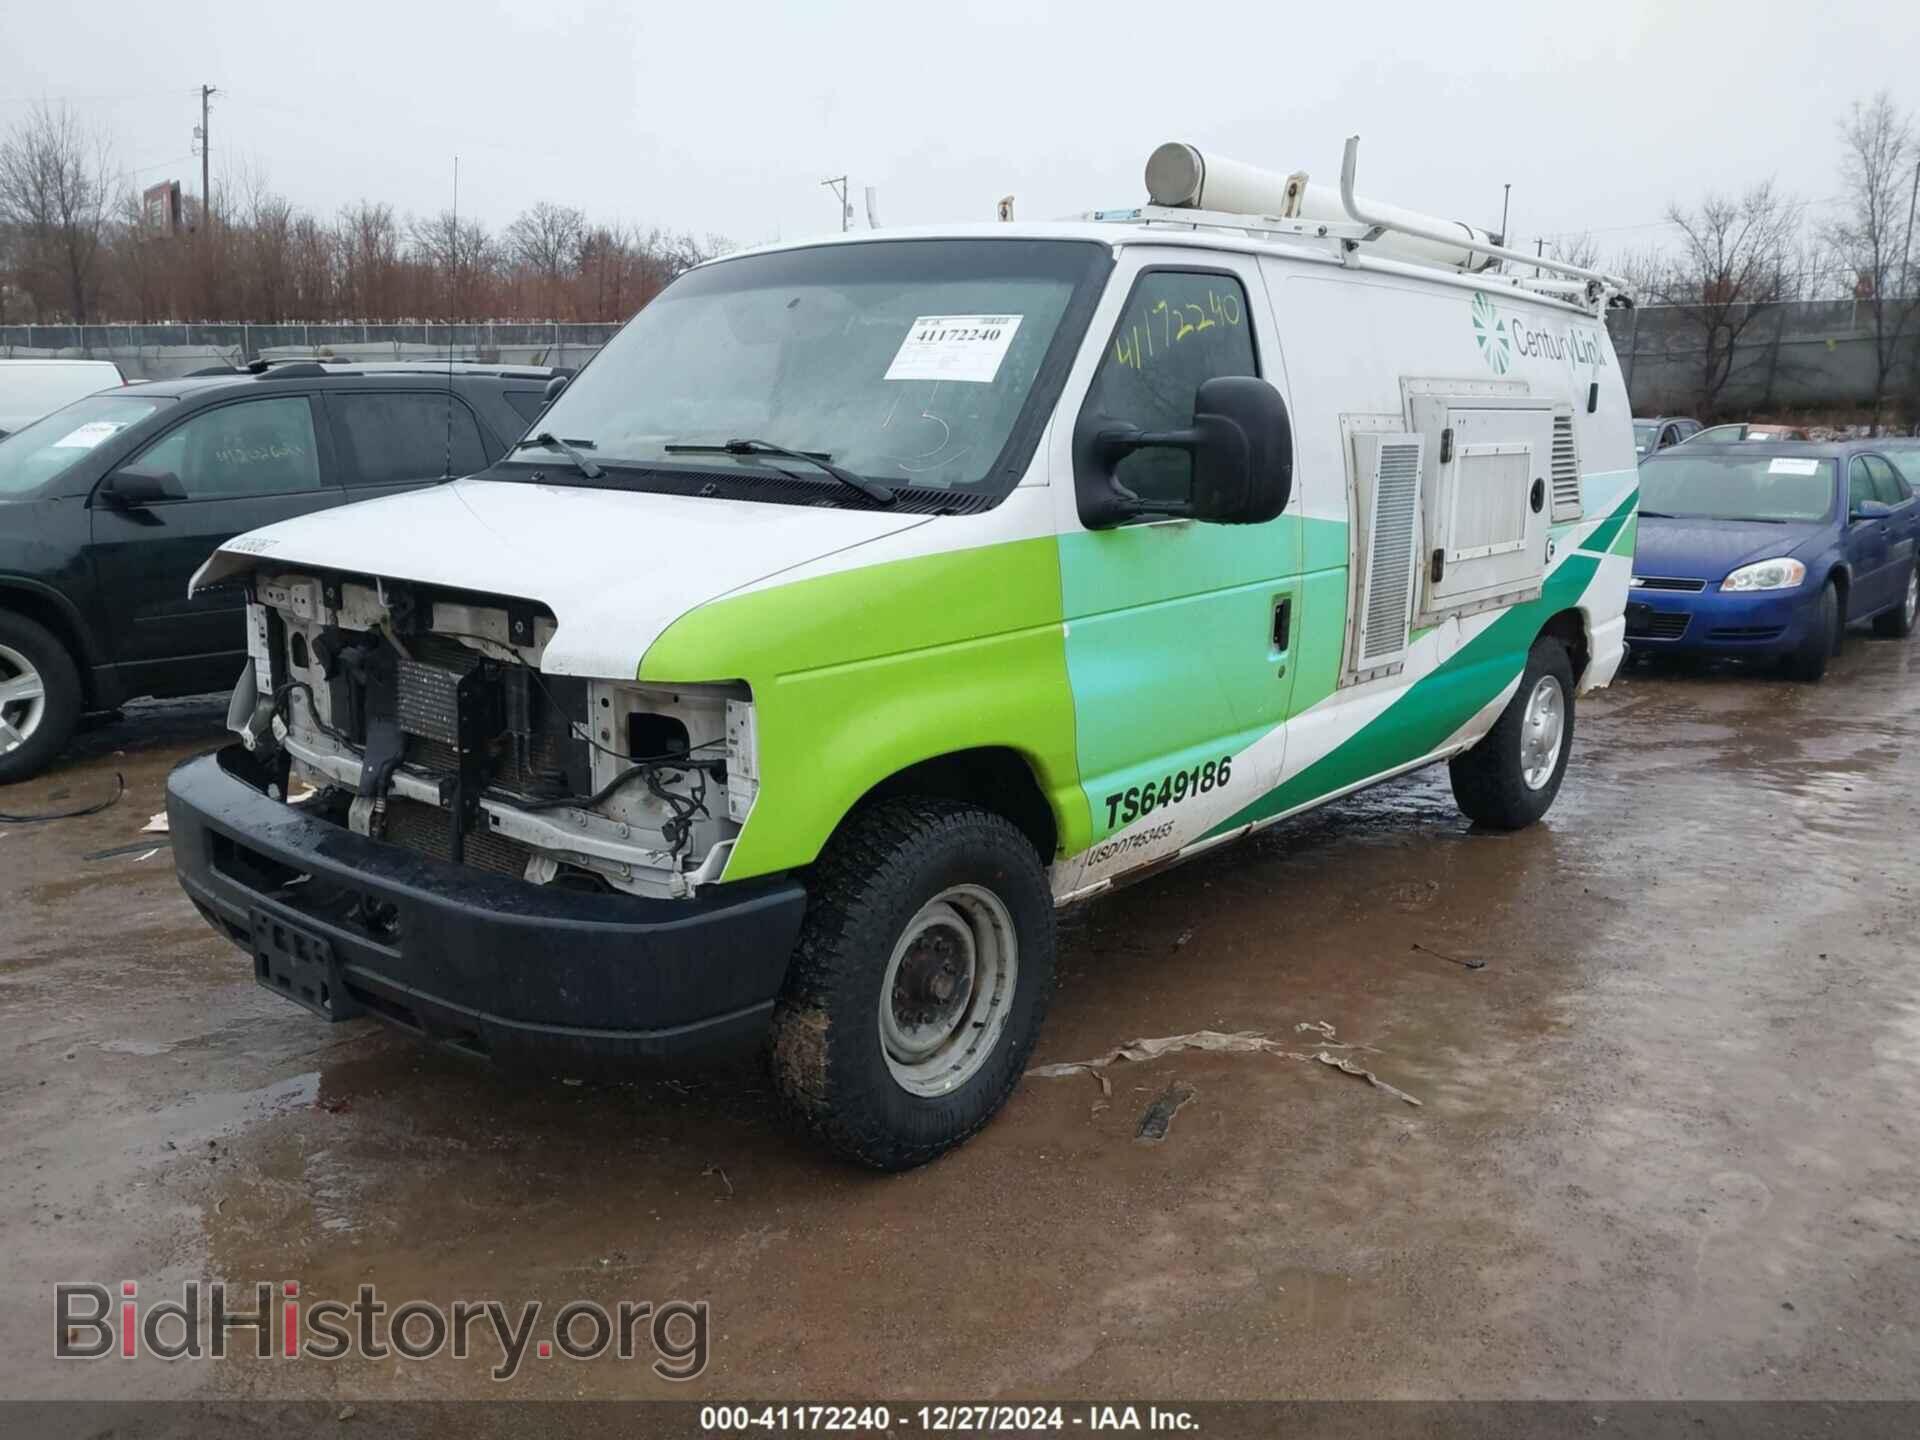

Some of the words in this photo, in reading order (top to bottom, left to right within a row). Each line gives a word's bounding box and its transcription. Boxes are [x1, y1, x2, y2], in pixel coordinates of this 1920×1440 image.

[916, 328, 1001, 342] 41172240
[1115, 289, 1240, 369] 41172240
[1106, 756, 1232, 829] TS649186
